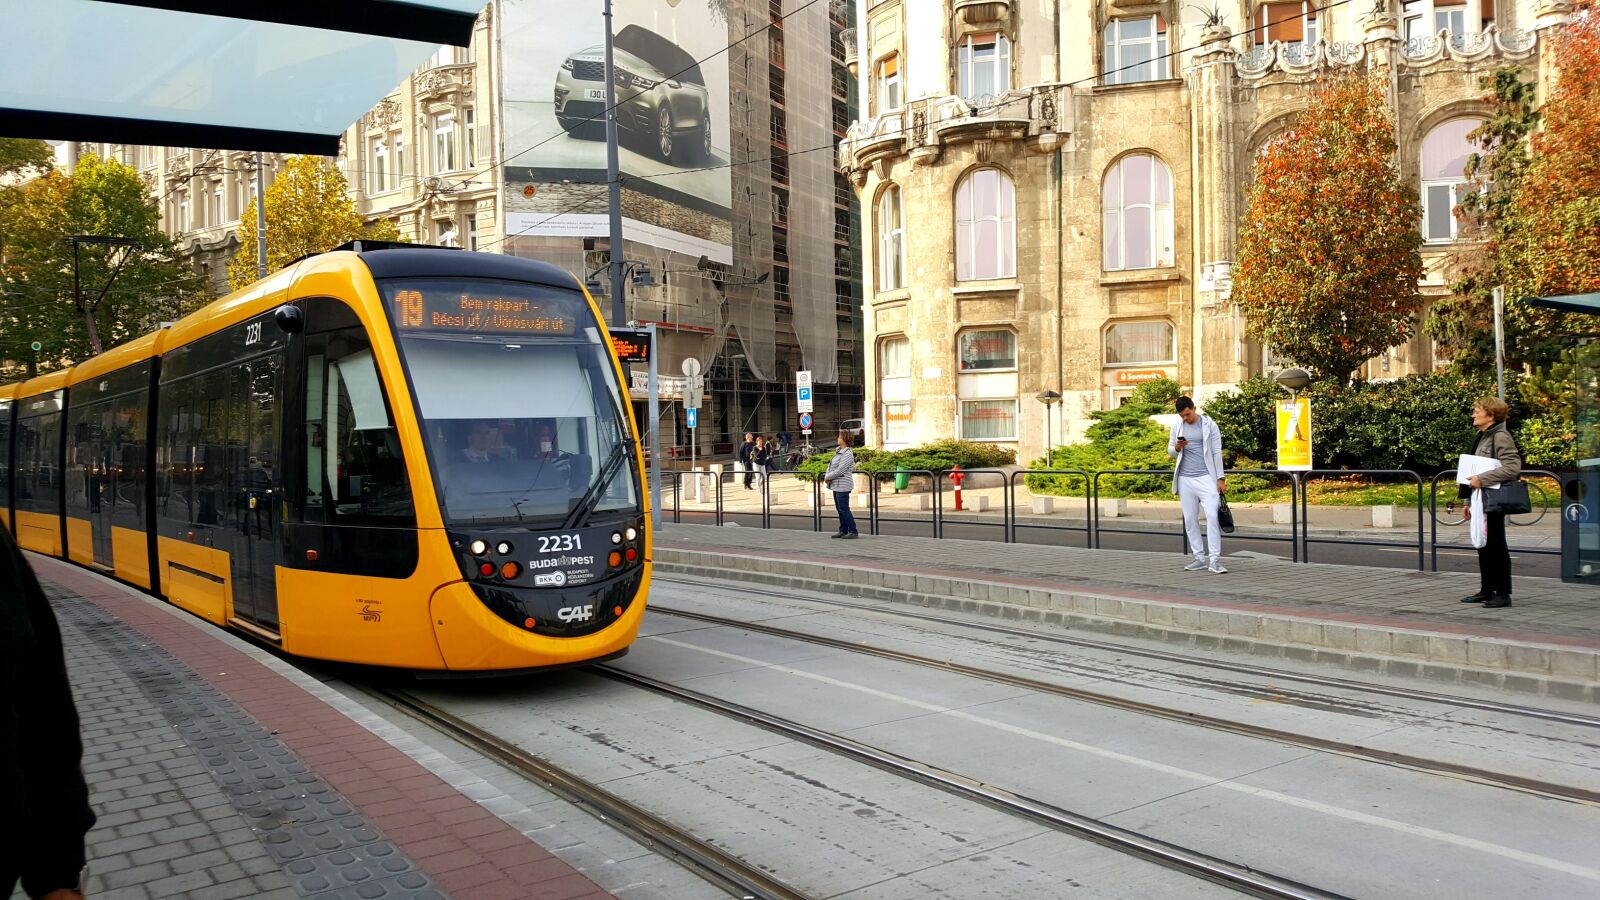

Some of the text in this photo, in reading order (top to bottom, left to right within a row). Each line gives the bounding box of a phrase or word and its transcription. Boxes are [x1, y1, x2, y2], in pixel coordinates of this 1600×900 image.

[395, 290, 423, 327] 19
[460, 295, 484, 310] Bem
[487, 299, 530, 312] rakpart
[431, 312, 465, 327] Bécsi
[467, 312, 481, 327] út
[552, 316, 564, 331] út
[245, 321, 262, 346] 2231
[537, 533, 583, 553] 2231
[557, 604, 593, 624] CAF
